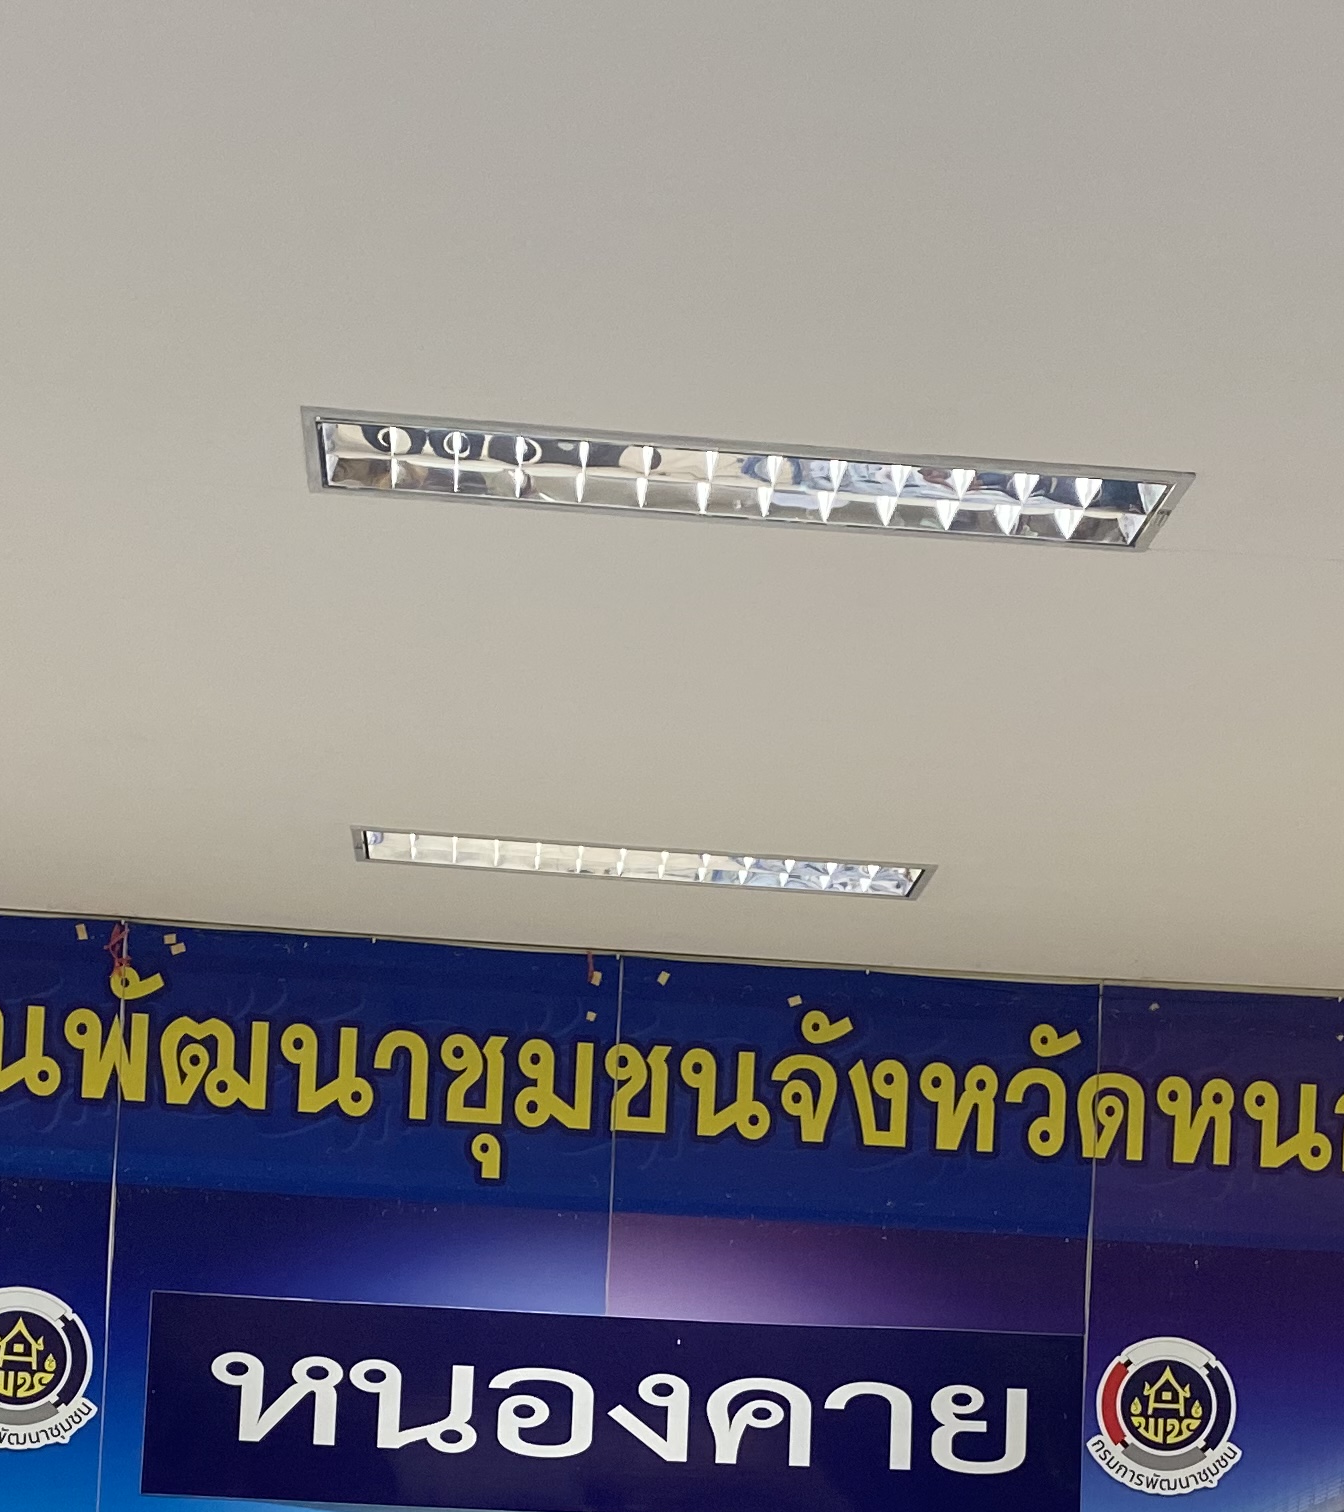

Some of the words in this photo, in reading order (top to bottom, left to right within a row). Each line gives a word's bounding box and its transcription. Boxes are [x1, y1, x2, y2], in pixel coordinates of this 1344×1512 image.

[210, 1350, 1029, 1476] หนองคาย
[1091, 1439, 1238, 1491] กรมการพัฒนาชุมชน
